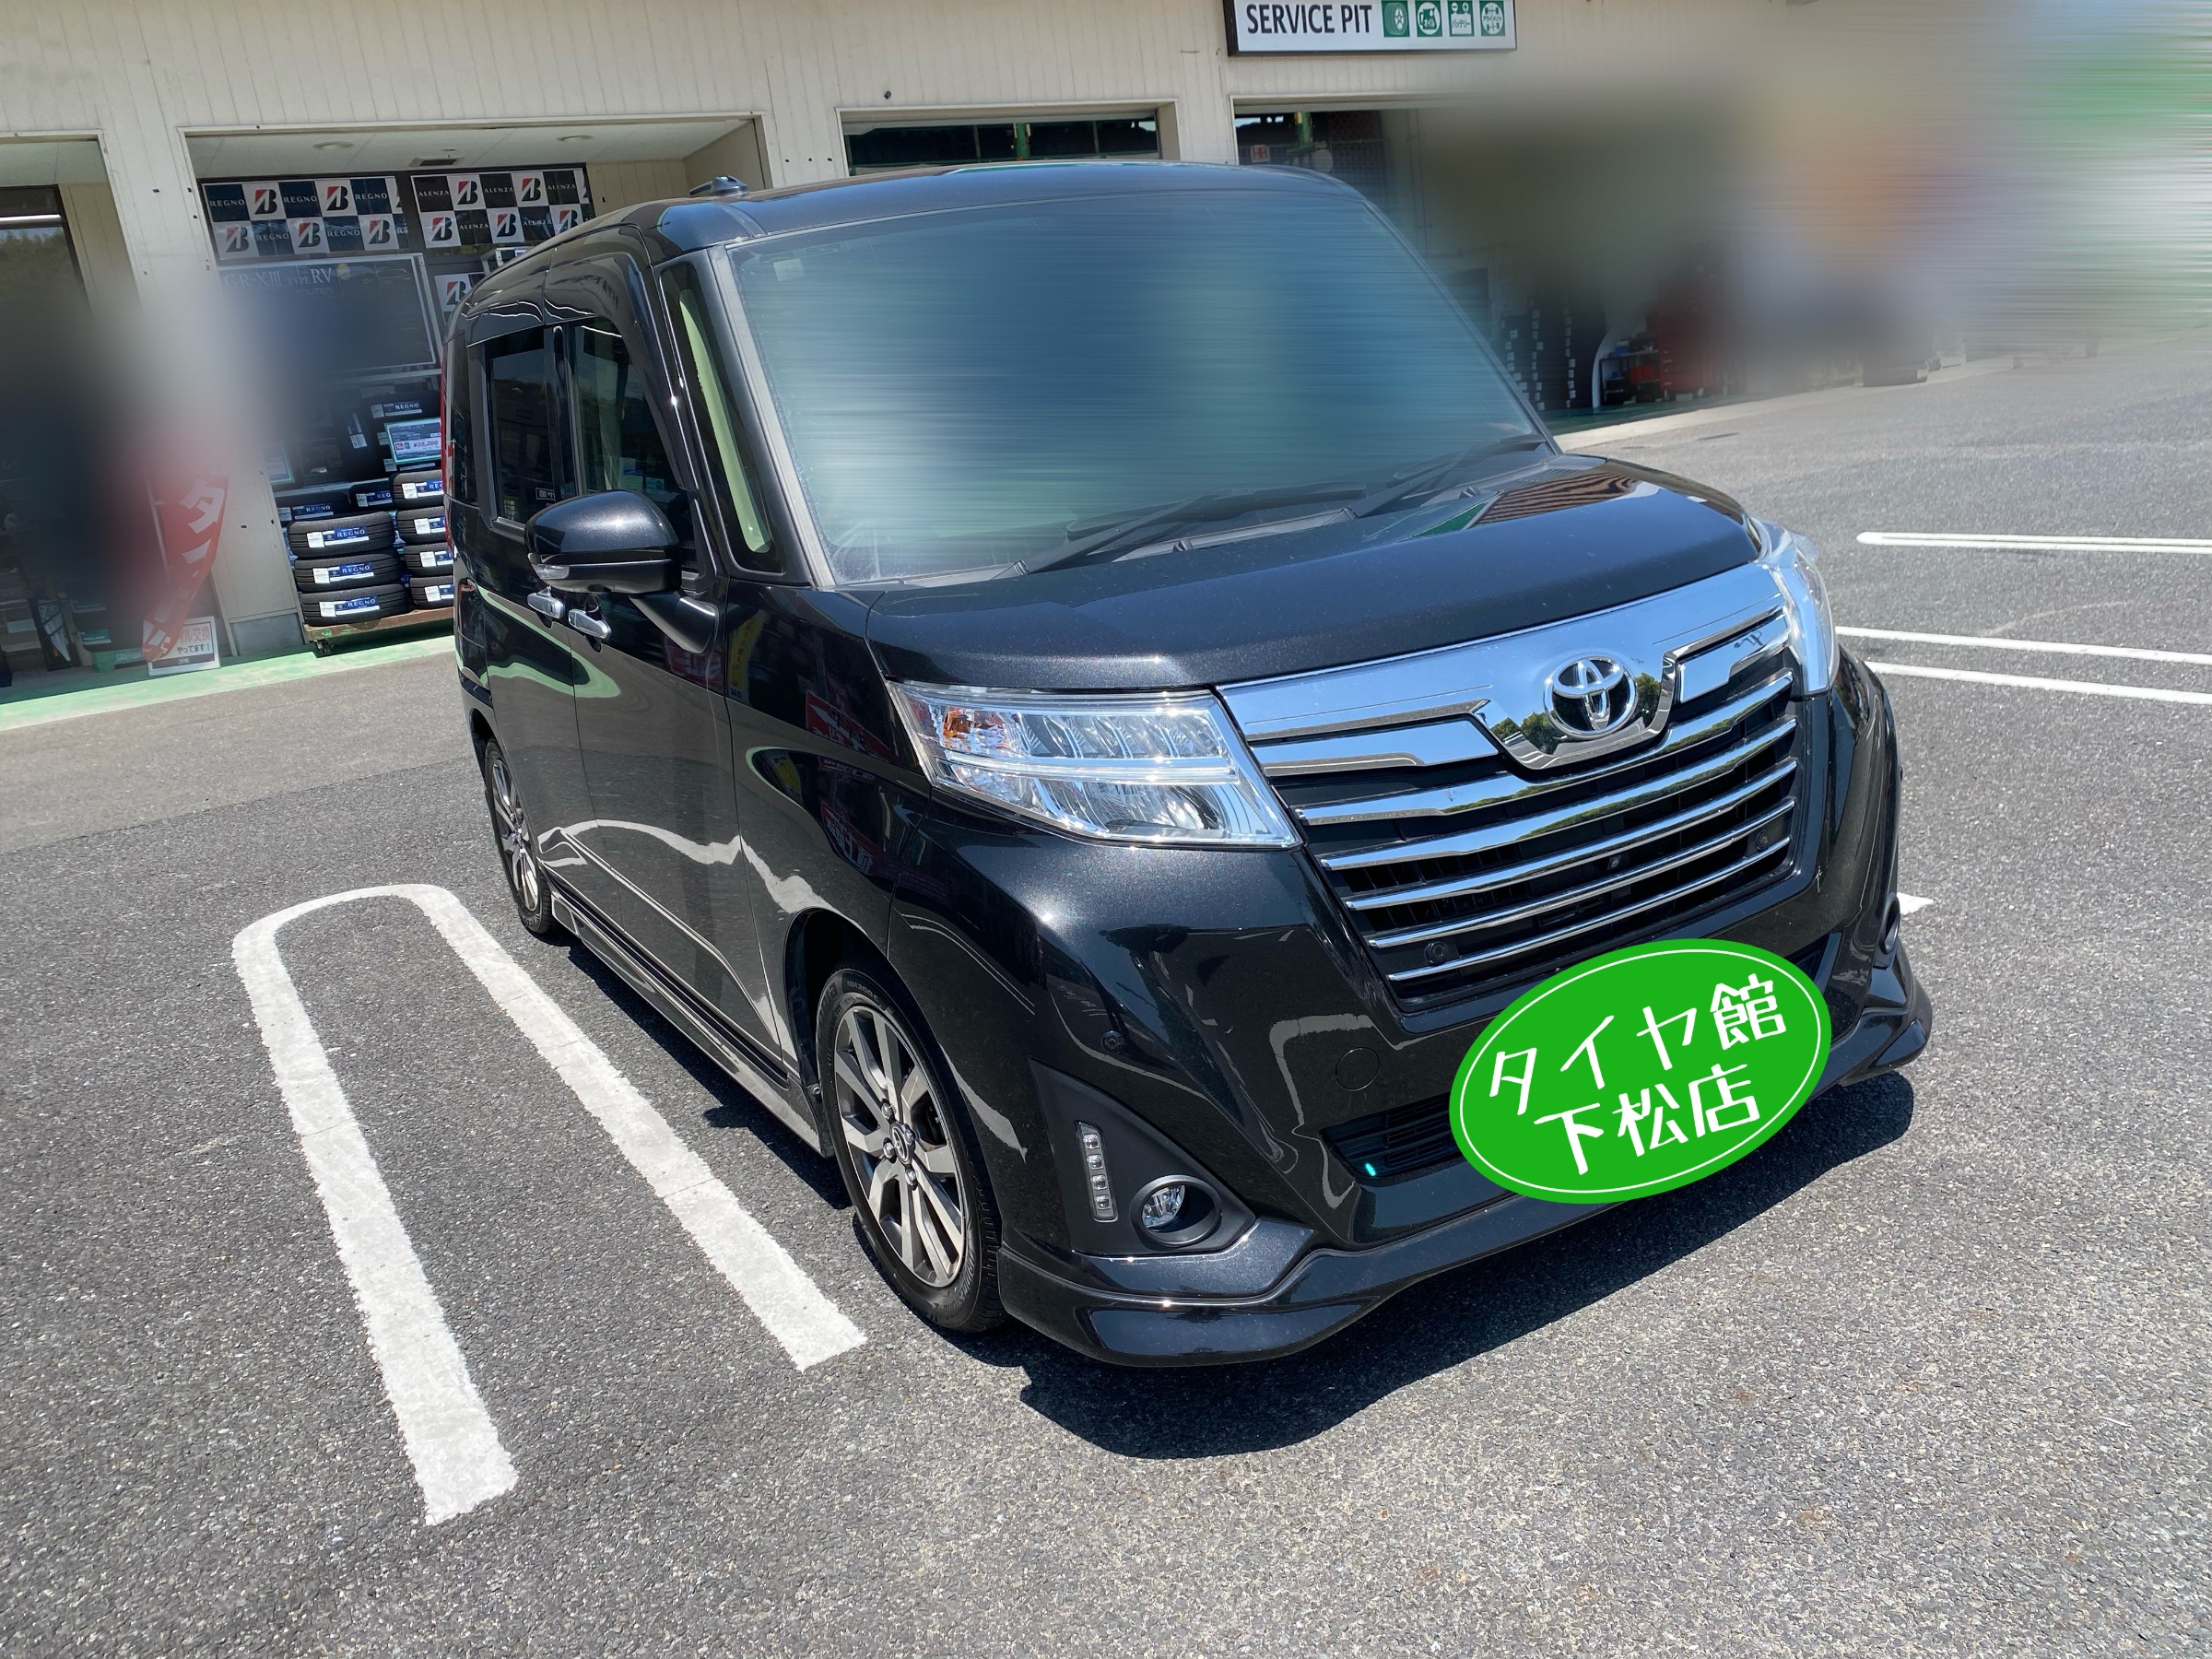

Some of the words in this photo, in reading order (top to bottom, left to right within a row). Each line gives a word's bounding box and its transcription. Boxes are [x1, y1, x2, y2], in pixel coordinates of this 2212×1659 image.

[1246, 4, 1335, 34] SERVICE
[1342, 4, 1372, 33] PIT
[283, 194, 317, 205] REGNO
[354, 192, 388, 201] REGNO
[208, 198, 245, 208] REGNO
[459, 222, 490, 230] ALENZA
[254, 231, 290, 241] REGNO
[327, 229, 361, 239] REGNO
[310, 267, 333, 285] RV
[394, 402, 419, 410] REGNO
[305, 504, 331, 512] REGNO
[336, 528, 366, 538] REGNO
[342, 564, 371, 575] REGNO
[347, 597, 376, 608] REGNO
